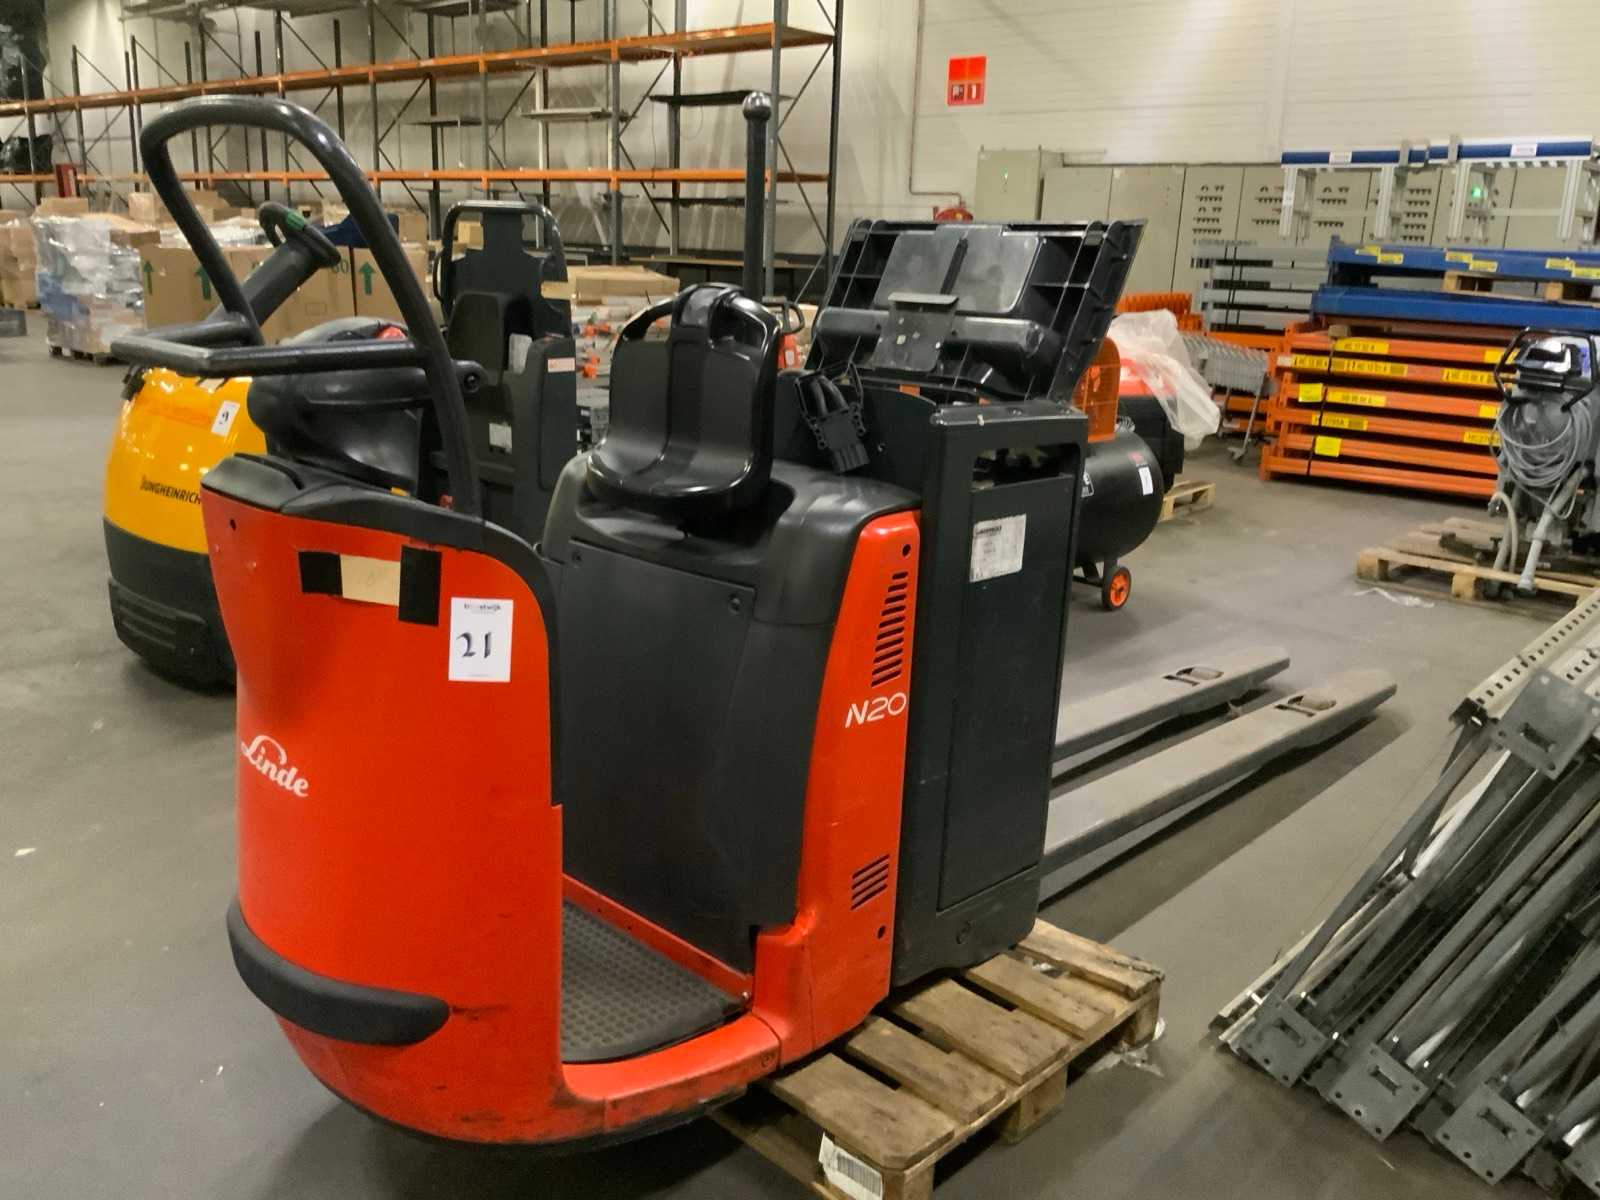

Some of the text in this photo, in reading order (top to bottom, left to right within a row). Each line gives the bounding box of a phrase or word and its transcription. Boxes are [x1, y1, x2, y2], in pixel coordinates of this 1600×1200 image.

[456, 632, 491, 658] 21
[845, 692, 907, 728] N20
[241, 733, 308, 798] Linde
